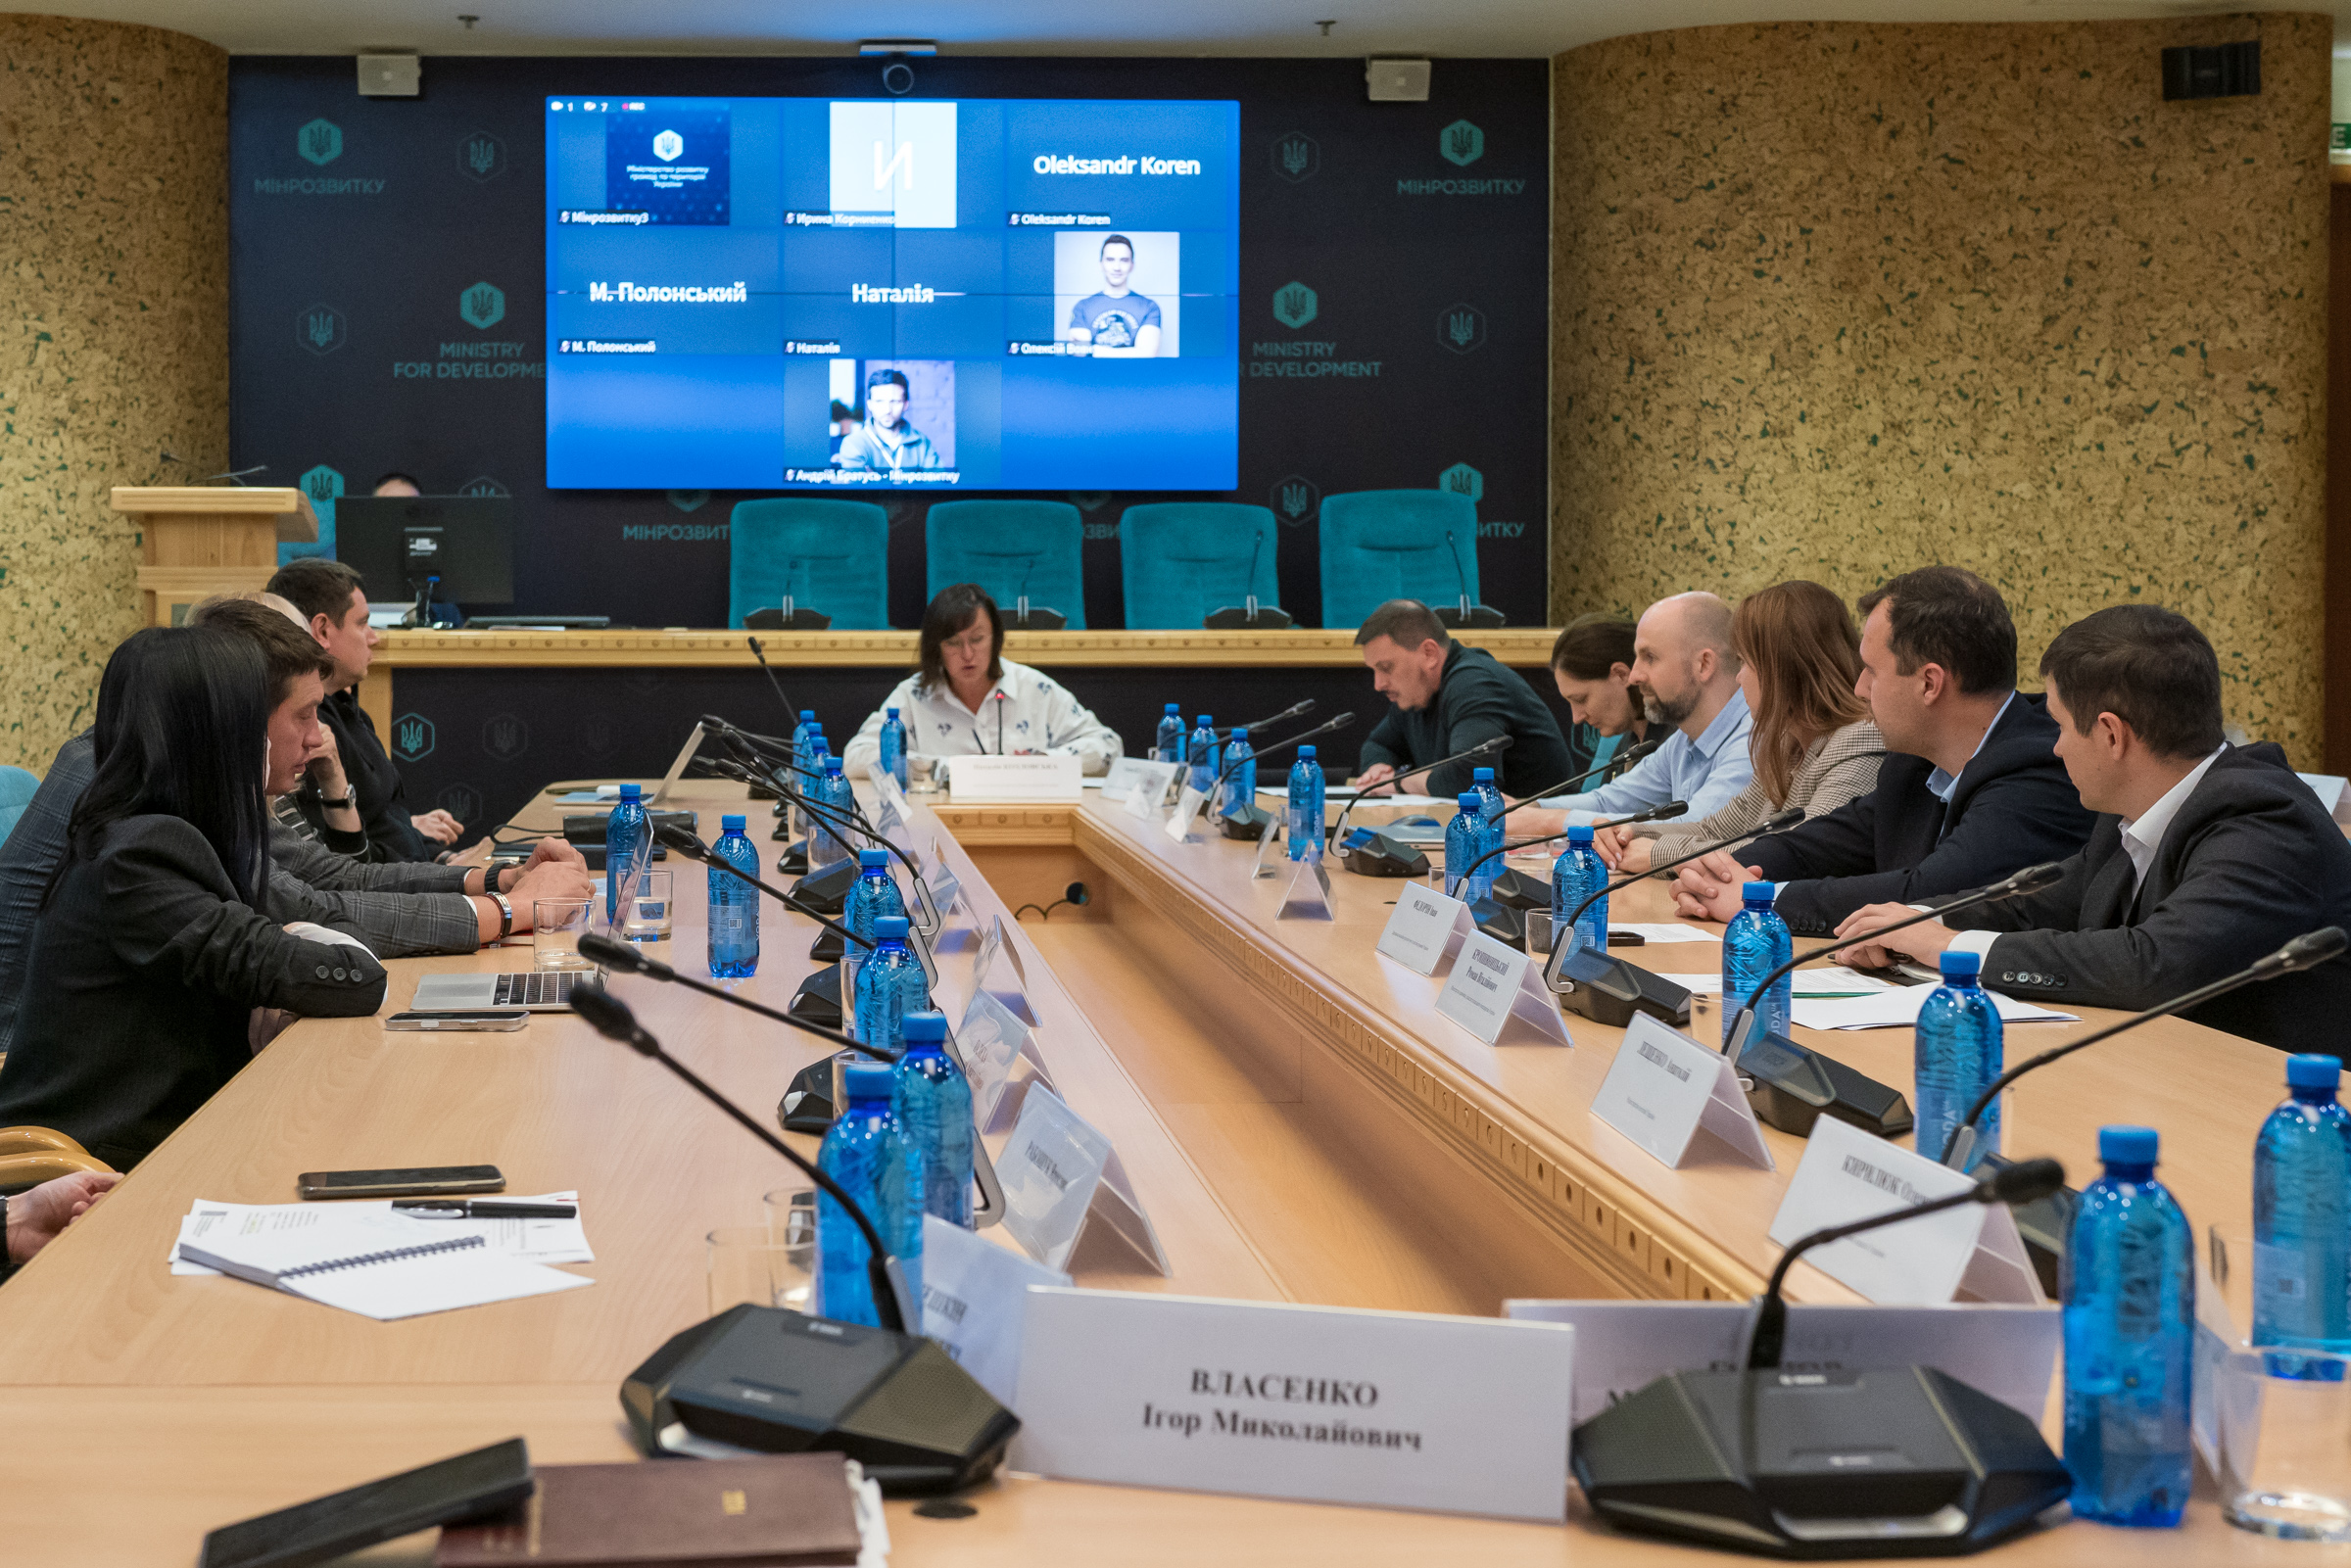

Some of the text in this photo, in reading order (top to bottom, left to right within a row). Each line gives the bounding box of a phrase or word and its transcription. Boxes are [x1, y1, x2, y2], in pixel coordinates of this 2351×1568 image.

[874, 140, 913, 191] И
[1033, 155, 1201, 175] Oleksandr Koren
[254, 177, 386, 194] МІНРОЗВИТКУ
[1397, 178, 1525, 195] МІНРОЗВИТКУ
[1021, 214, 1111, 225] Oleksandr Koren
[589, 281, 747, 303] М. Полонський
[852, 283, 935, 304] Наталія
[439, 342, 525, 358] MINISTRY
[572, 340, 656, 354] М. Полонський
[796, 342, 840, 354] Наталія
[1252, 342, 1336, 357] MINISTRY
[394, 362, 547, 379] FOR DEVELOPME
[1249, 361, 1382, 377] DEVELOPMENT
[795, 469, 837, 484] Андрій
[623, 524, 731, 541] МІНРОЗВИТ
[1189, 1367, 1380, 1410] ВЛАСЕНКО
[1142, 1402, 1422, 1453] Ігор Миколайович
